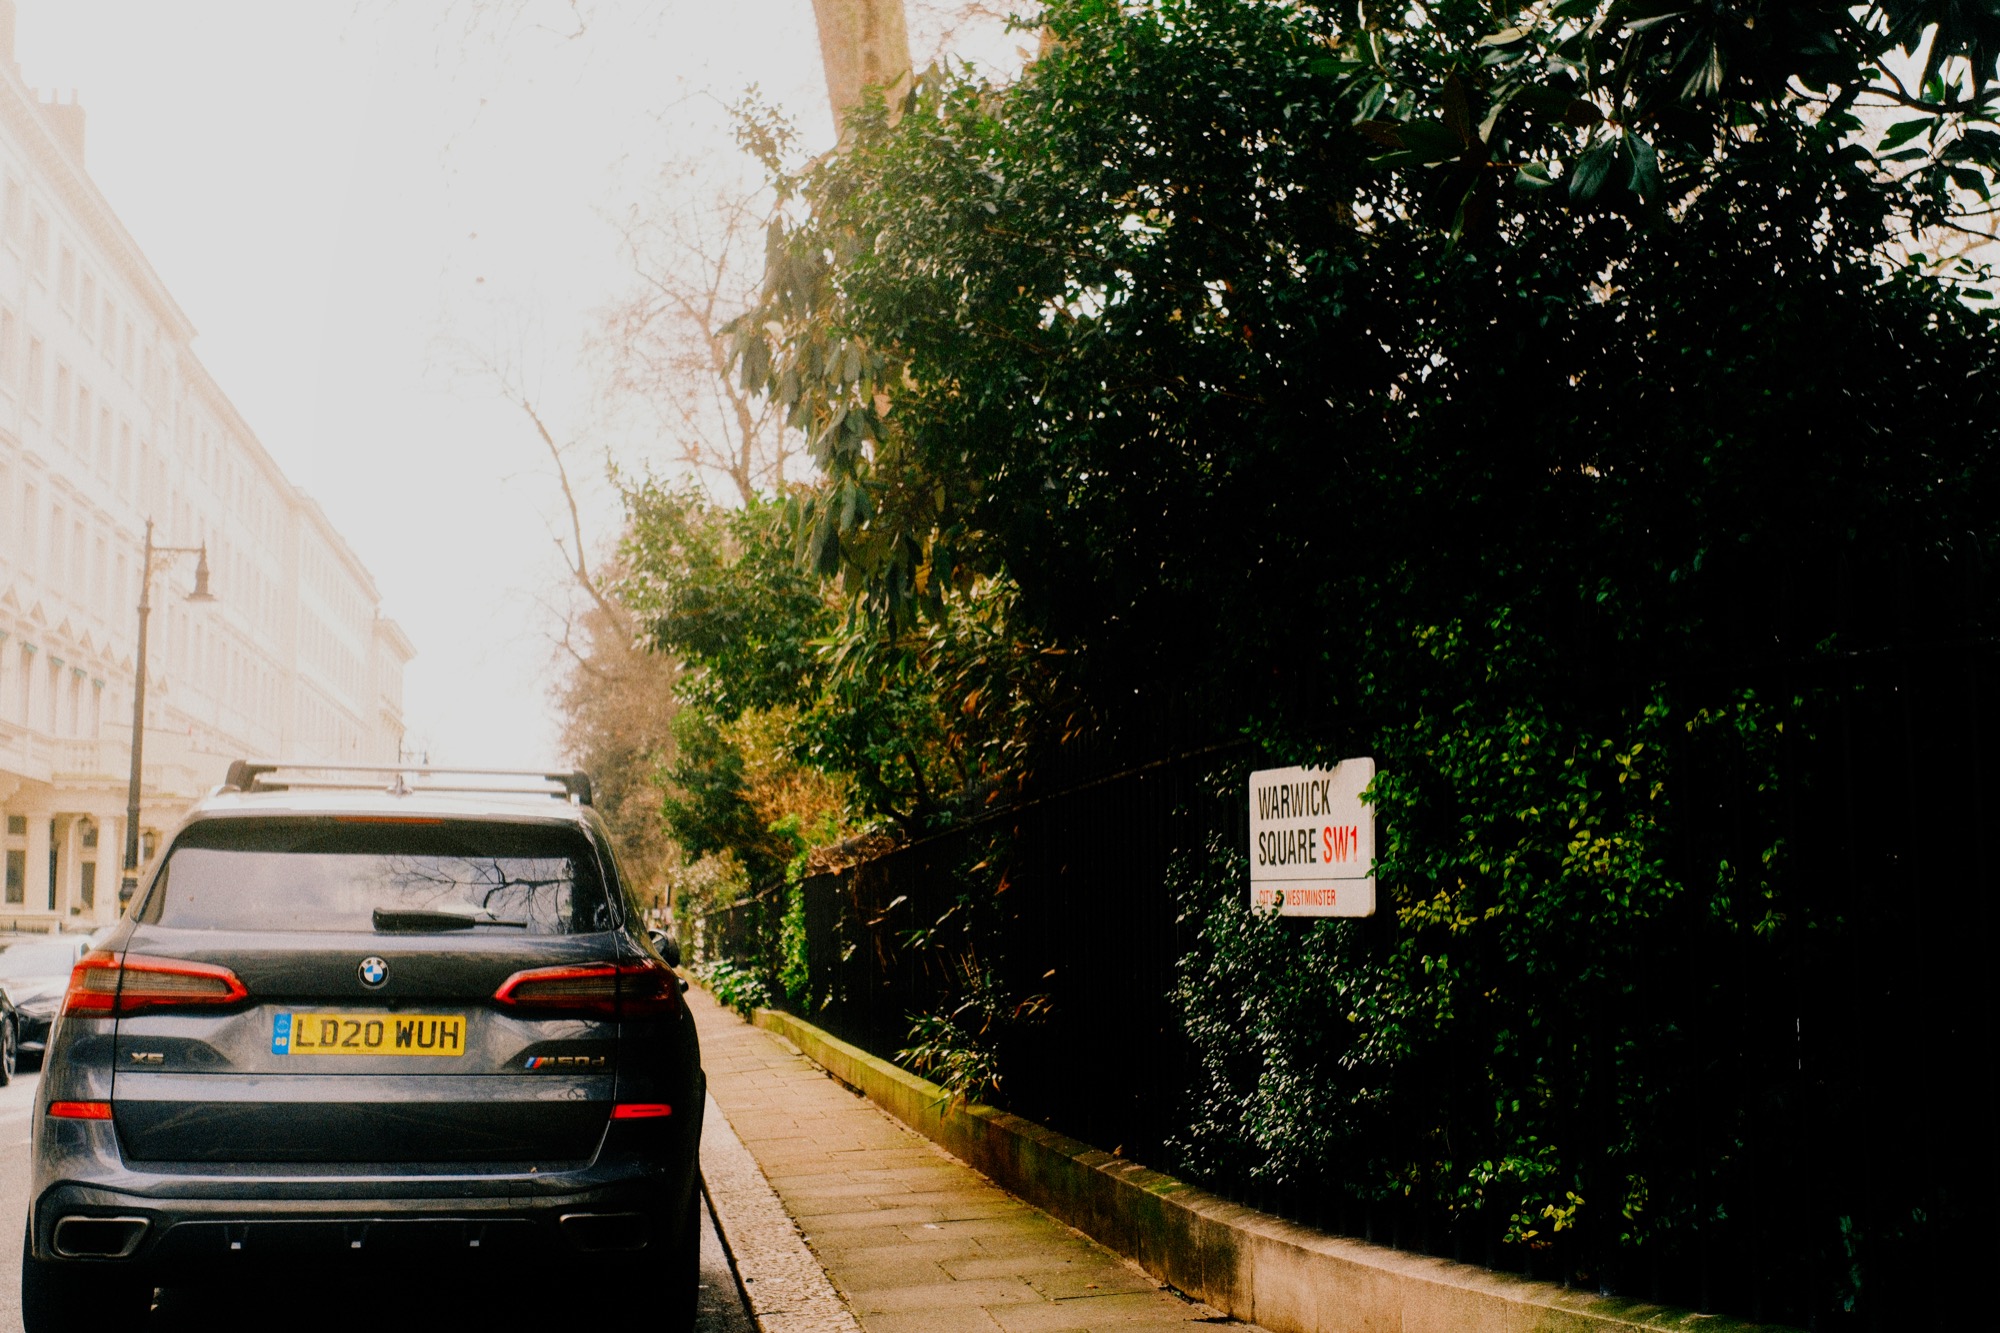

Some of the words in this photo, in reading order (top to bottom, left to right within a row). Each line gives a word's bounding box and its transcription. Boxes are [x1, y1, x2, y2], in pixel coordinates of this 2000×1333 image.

[1258, 779, 1331, 820] WARWICK
[1258, 828, 1317, 867] SQUARE
[1322, 825, 1358, 864] SW1
[1259, 889, 1274, 905] CITY
[1285, 889, 1337, 906] WESTMINSTER
[295, 1018, 385, 1048] LD20
[395, 1019, 460, 1049] WUH
